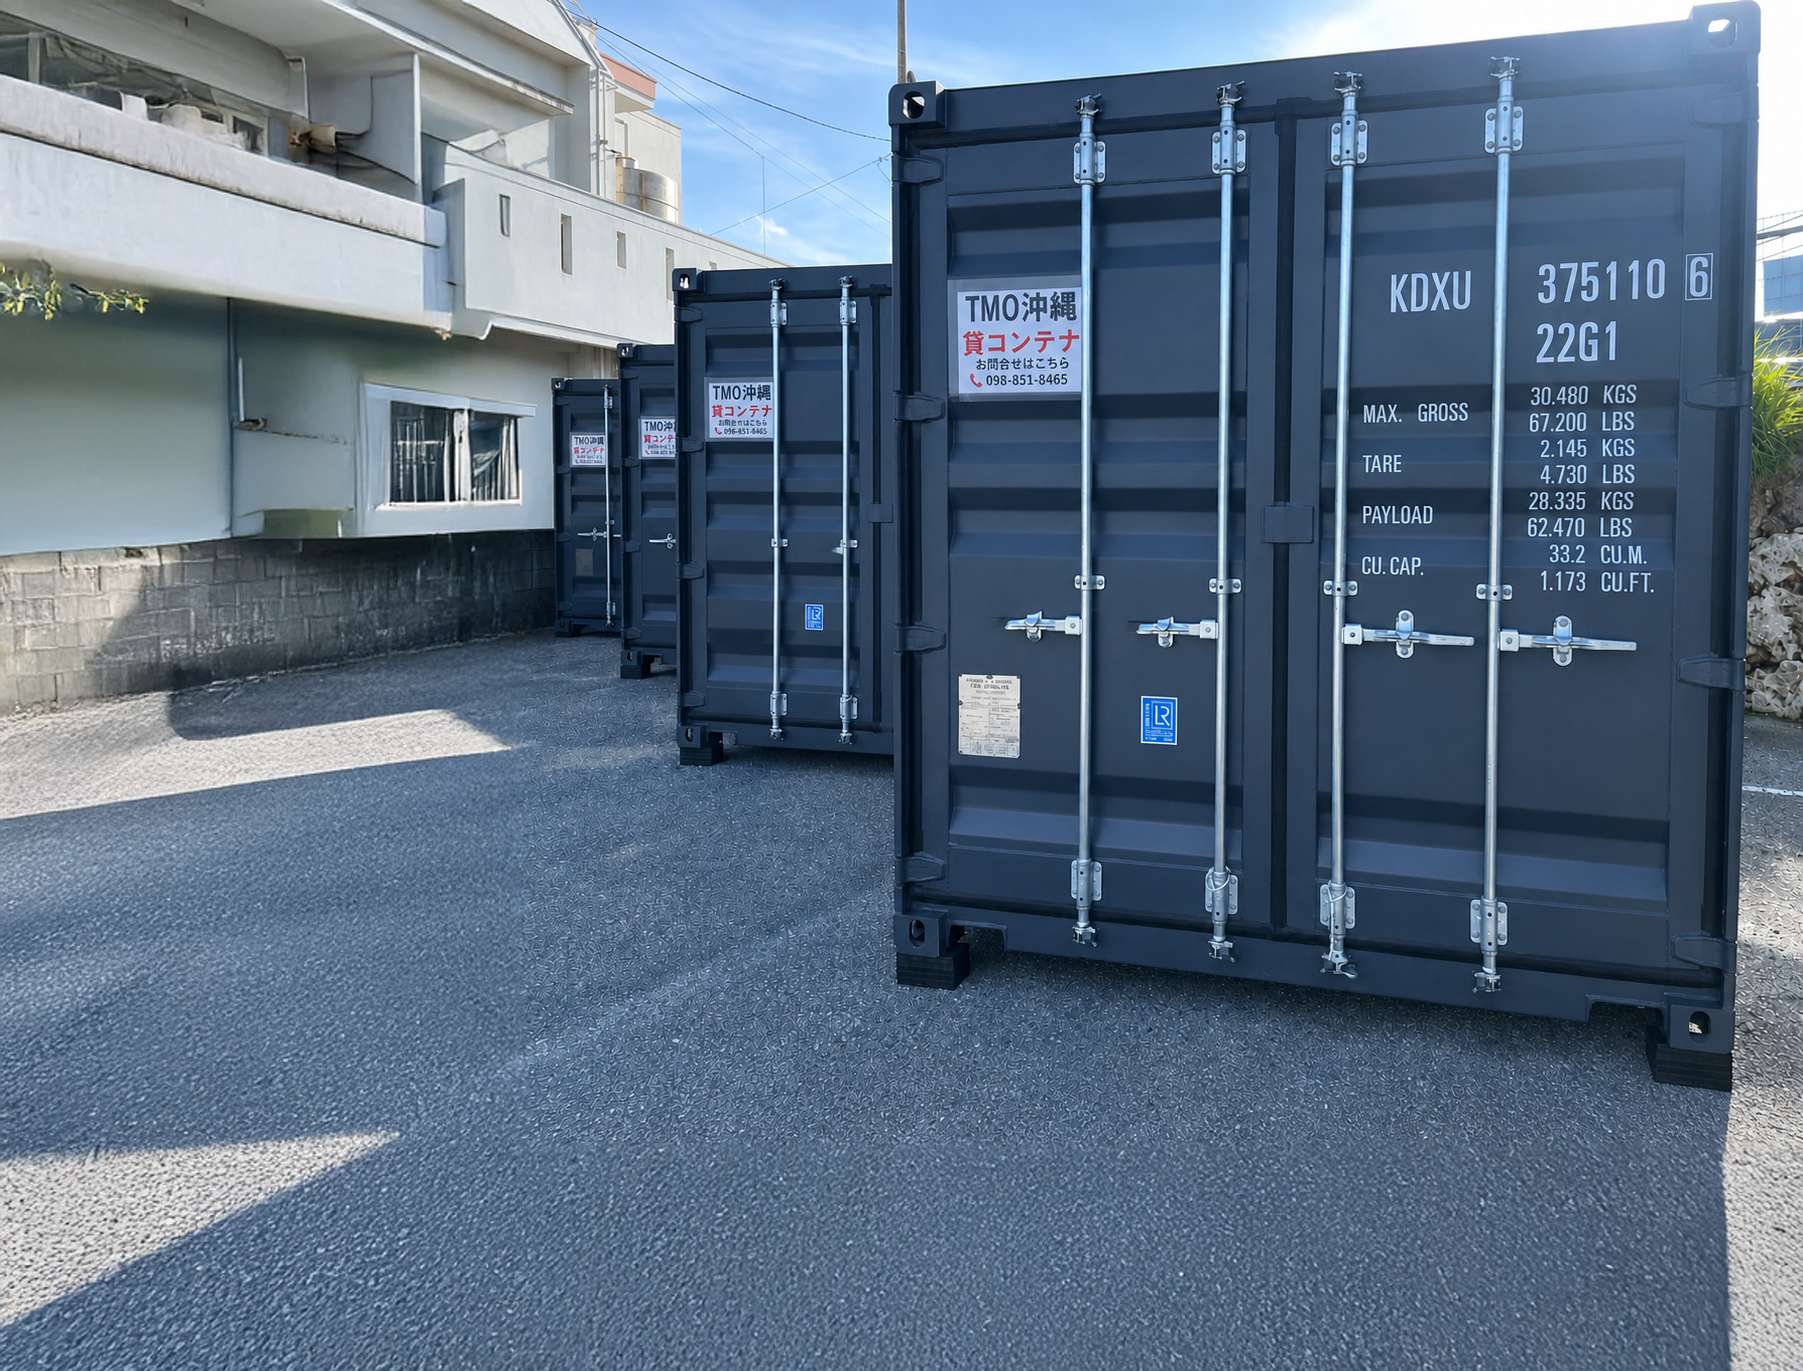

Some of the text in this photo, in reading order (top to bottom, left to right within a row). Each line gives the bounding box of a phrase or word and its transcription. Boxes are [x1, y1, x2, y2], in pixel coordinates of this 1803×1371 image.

[1390, 256, 1709, 313] KDXU 375110 6
[964, 291, 1078, 322] TMO沖縄
[962, 328, 1080, 357] 貸コンテナ
[1536, 320, 1617, 364] 22G1
[976, 357, 1069, 371] お問合せはこちら
[986, 373, 1068, 386] 098-851-8465
[1530, 384, 1637, 406] 30.480 KGS
[1363, 402, 1469, 423] MAX. GROSS
[1529, 411, 1635, 433] 67.200 LBS
[1540, 438, 1635, 458] 2.145 KGS
[1363, 454, 1402, 473] TARE
[1540, 464, 1635, 484] 4.730 LBS
[1528, 491, 1634, 511] 28.335 KGS
[1362, 505, 1433, 524] PAYLOAD
[1527, 518, 1633, 538] 62.470 LBS
[1549, 544, 1648, 565] 33.2 CU.M.
[1540, 571, 1655, 593] 1.173 CU.FT.
